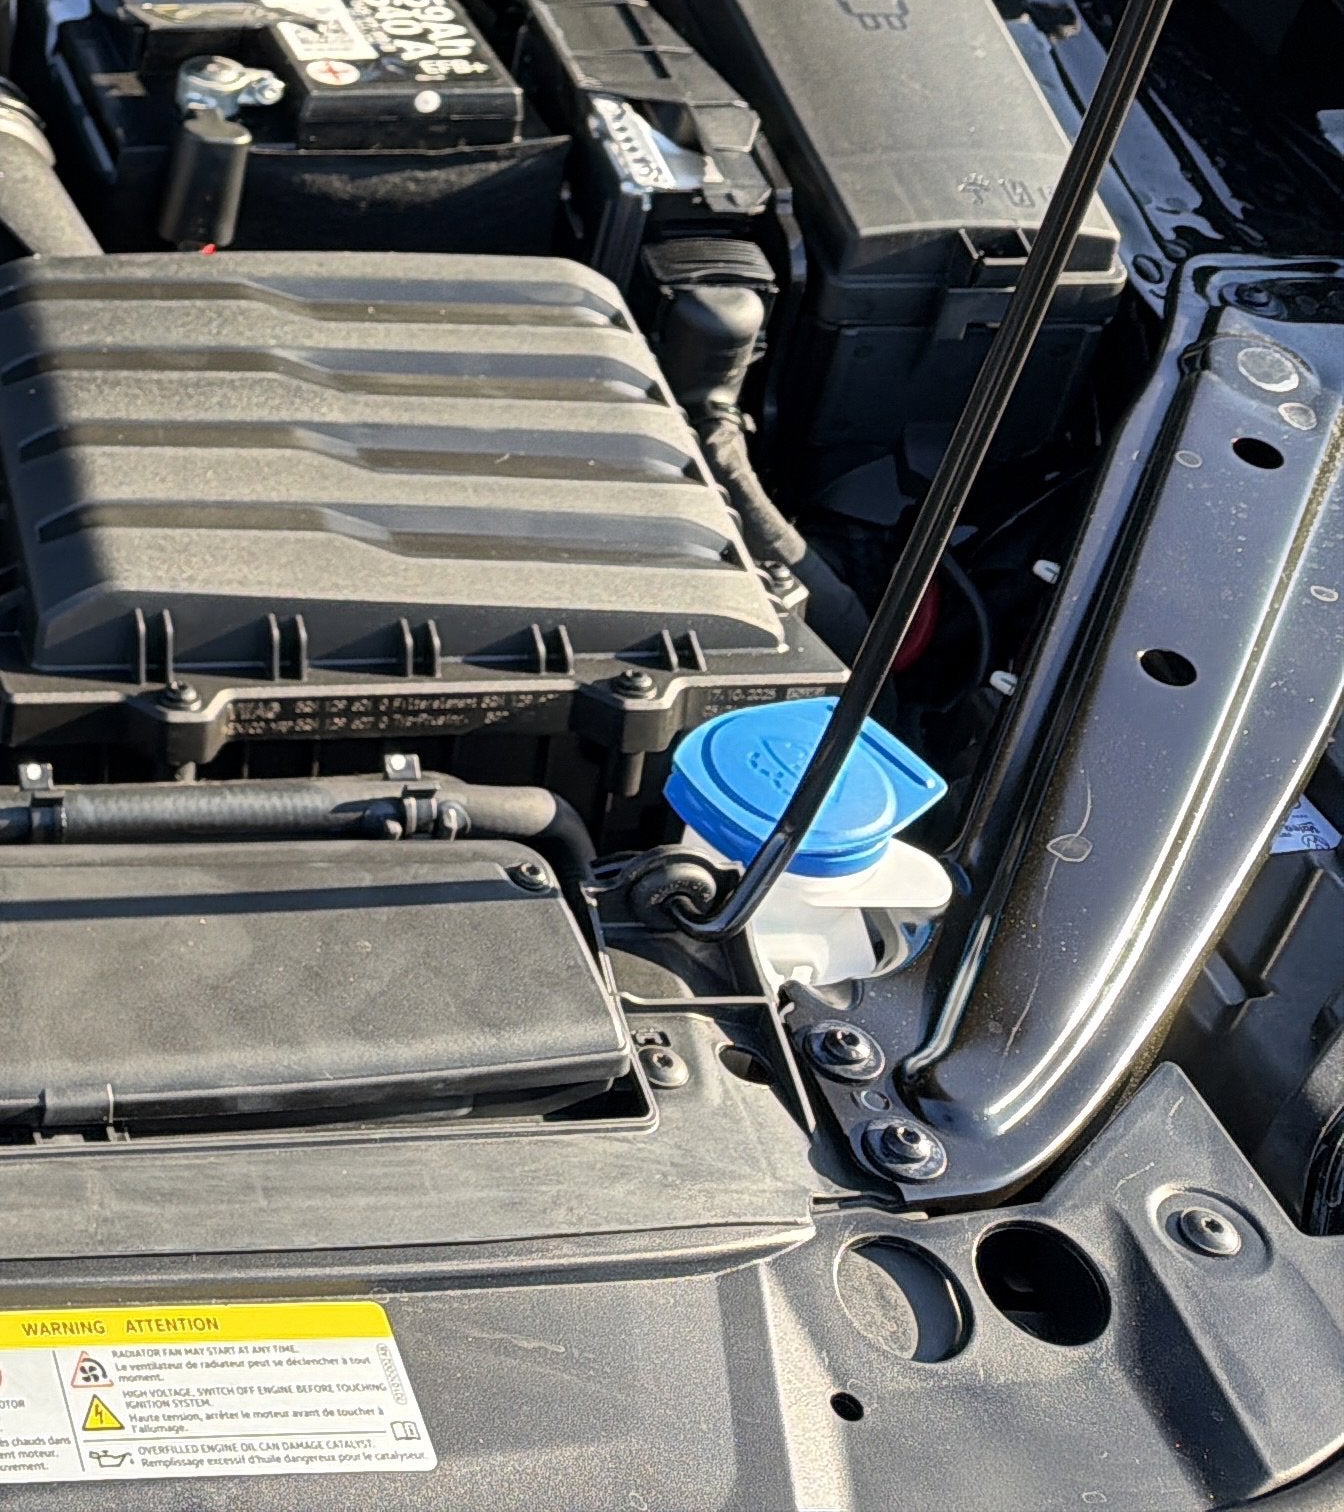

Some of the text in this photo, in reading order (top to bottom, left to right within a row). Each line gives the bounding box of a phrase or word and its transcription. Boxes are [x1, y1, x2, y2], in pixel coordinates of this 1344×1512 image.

[21, 1317, 220, 1337] WARNING ATTENTION
[112, 1348, 162, 1359] RADIATOR
[162, 1347, 182, 1358] FAN
[184, 1346, 205, 1357] MAY
[207, 1345, 236, 1356] START
[238, 1345, 249, 1354] AT
[252, 1345, 271, 1354] ANY
[115, 1362, 127, 1372] Le
[129, 1360, 183, 1371] ventilateur
[185, 1360, 198, 1370] de
[200, 1358, 245, 1369] radiateur
[247, 1357, 270, 1369] peut
[272, 1359, 283, 1367] se
[341, 1356, 348, 1366] à
[349, 1356, 371, 1366] tout
[118, 1374, 164, 1383] moment.
[122, 1389, 148, 1399] HIGH
[196, 1386, 234, 1397] SWITCH
[236, 1385, 255, 1396] OFF
[257, 1384, 294, 1395] ENGINE
[295, 1383, 335, 1394] BEFORE
[336, 1382, 387, 1393] TOUCHING
[124, 1399, 171, 1409] IGNITION
[128, 1413, 160, 1423] Haute
[240, 1410, 251, 1419] le
[253, 1409, 290, 1418] moteur
[292, 1408, 321, 1418] avant
[322, 1407, 335, 1417] de
[337, 1406, 376, 1417] toucher
[377, 1406, 385, 1415] à
[11, 1436, 47, 1447] chauds
[47, 1435, 72, 1446] dans
[137, 1444, 200, 1456] OVERFILLED
[200, 1443, 239, 1454] ENGINE
[240, 1442, 256, 1453] OIL
[258, 1441, 281, 1452] CAN
[281, 1440, 324, 1451] DAMAGE
[140, 1456, 205, 1469] Remplissage
[283, 1453, 337, 1465] dangereux
[338, 1452, 361, 1464] pour
[363, 1451, 373, 1461] le
